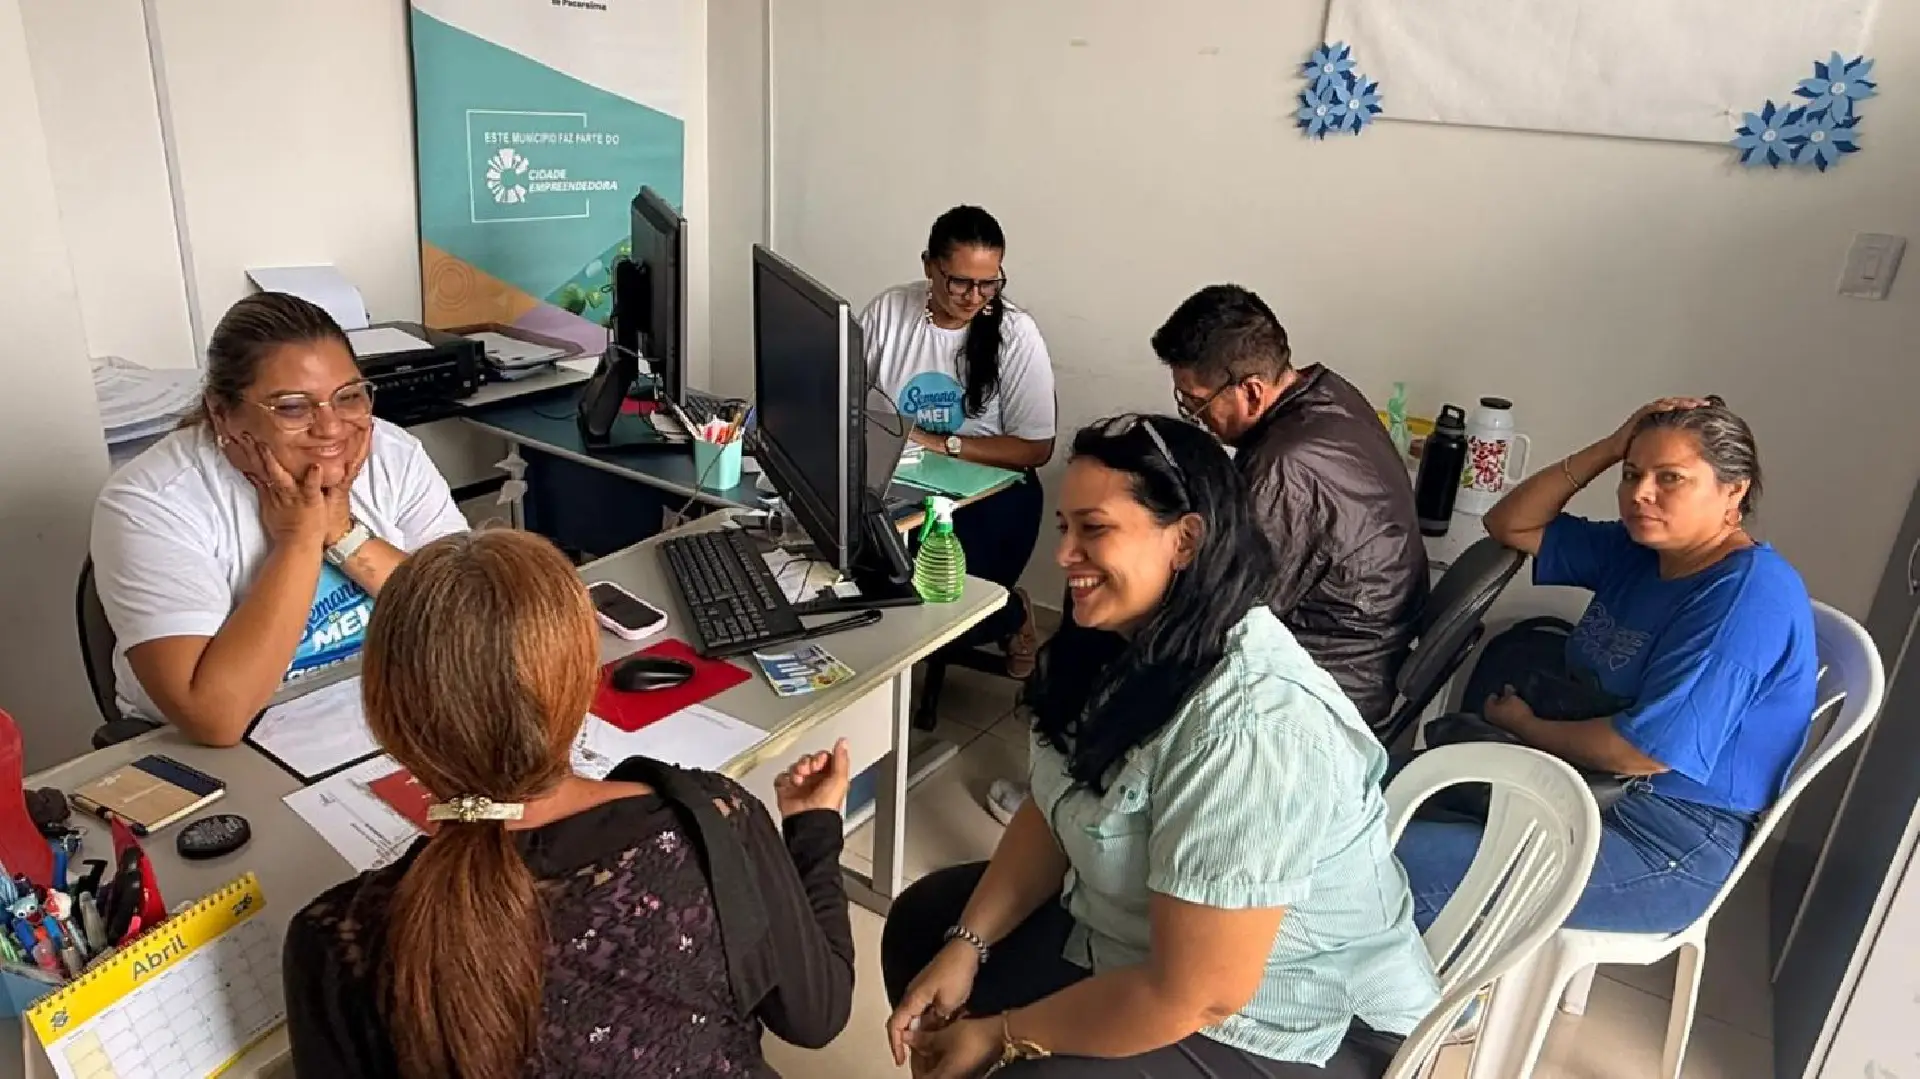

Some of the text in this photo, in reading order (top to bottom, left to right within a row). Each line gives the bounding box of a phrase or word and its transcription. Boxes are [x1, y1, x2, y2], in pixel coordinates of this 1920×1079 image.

[484, 131, 509, 144] ESTE
[558, 132, 574, 144] FAZ
[576, 132, 603, 145] PARTE
[605, 133, 620, 145] DO
[528, 169, 566, 180] CIDADE
[528, 181, 618, 192] EMPREENDEDORA
[904, 386, 958, 414] Semana
[917, 408, 950, 423] MEI
[312, 602, 371, 653] MEI
[133, 934, 188, 981] Abril
